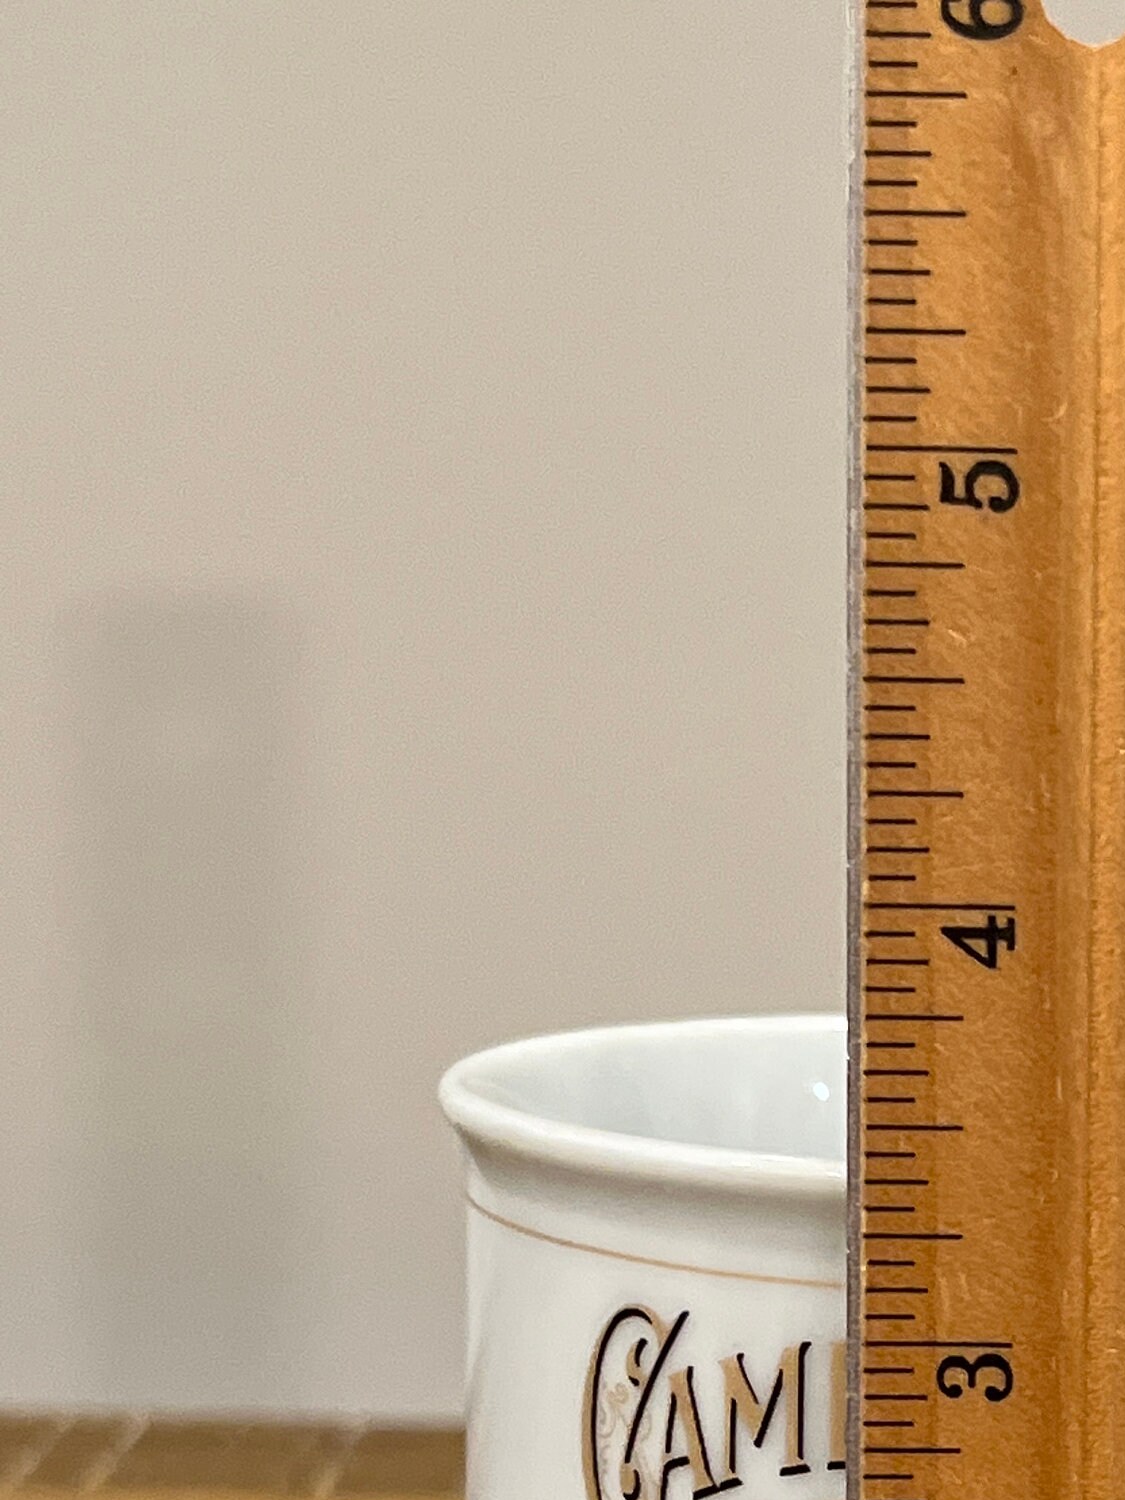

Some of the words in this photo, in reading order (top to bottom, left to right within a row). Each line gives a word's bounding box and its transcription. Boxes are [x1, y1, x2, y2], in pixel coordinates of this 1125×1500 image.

[941, 0, 1024, 40] 6
[939, 460, 1020, 513] 5
[940, 915, 1016, 969] 4
[937, 1353, 1013, 1401] 3
